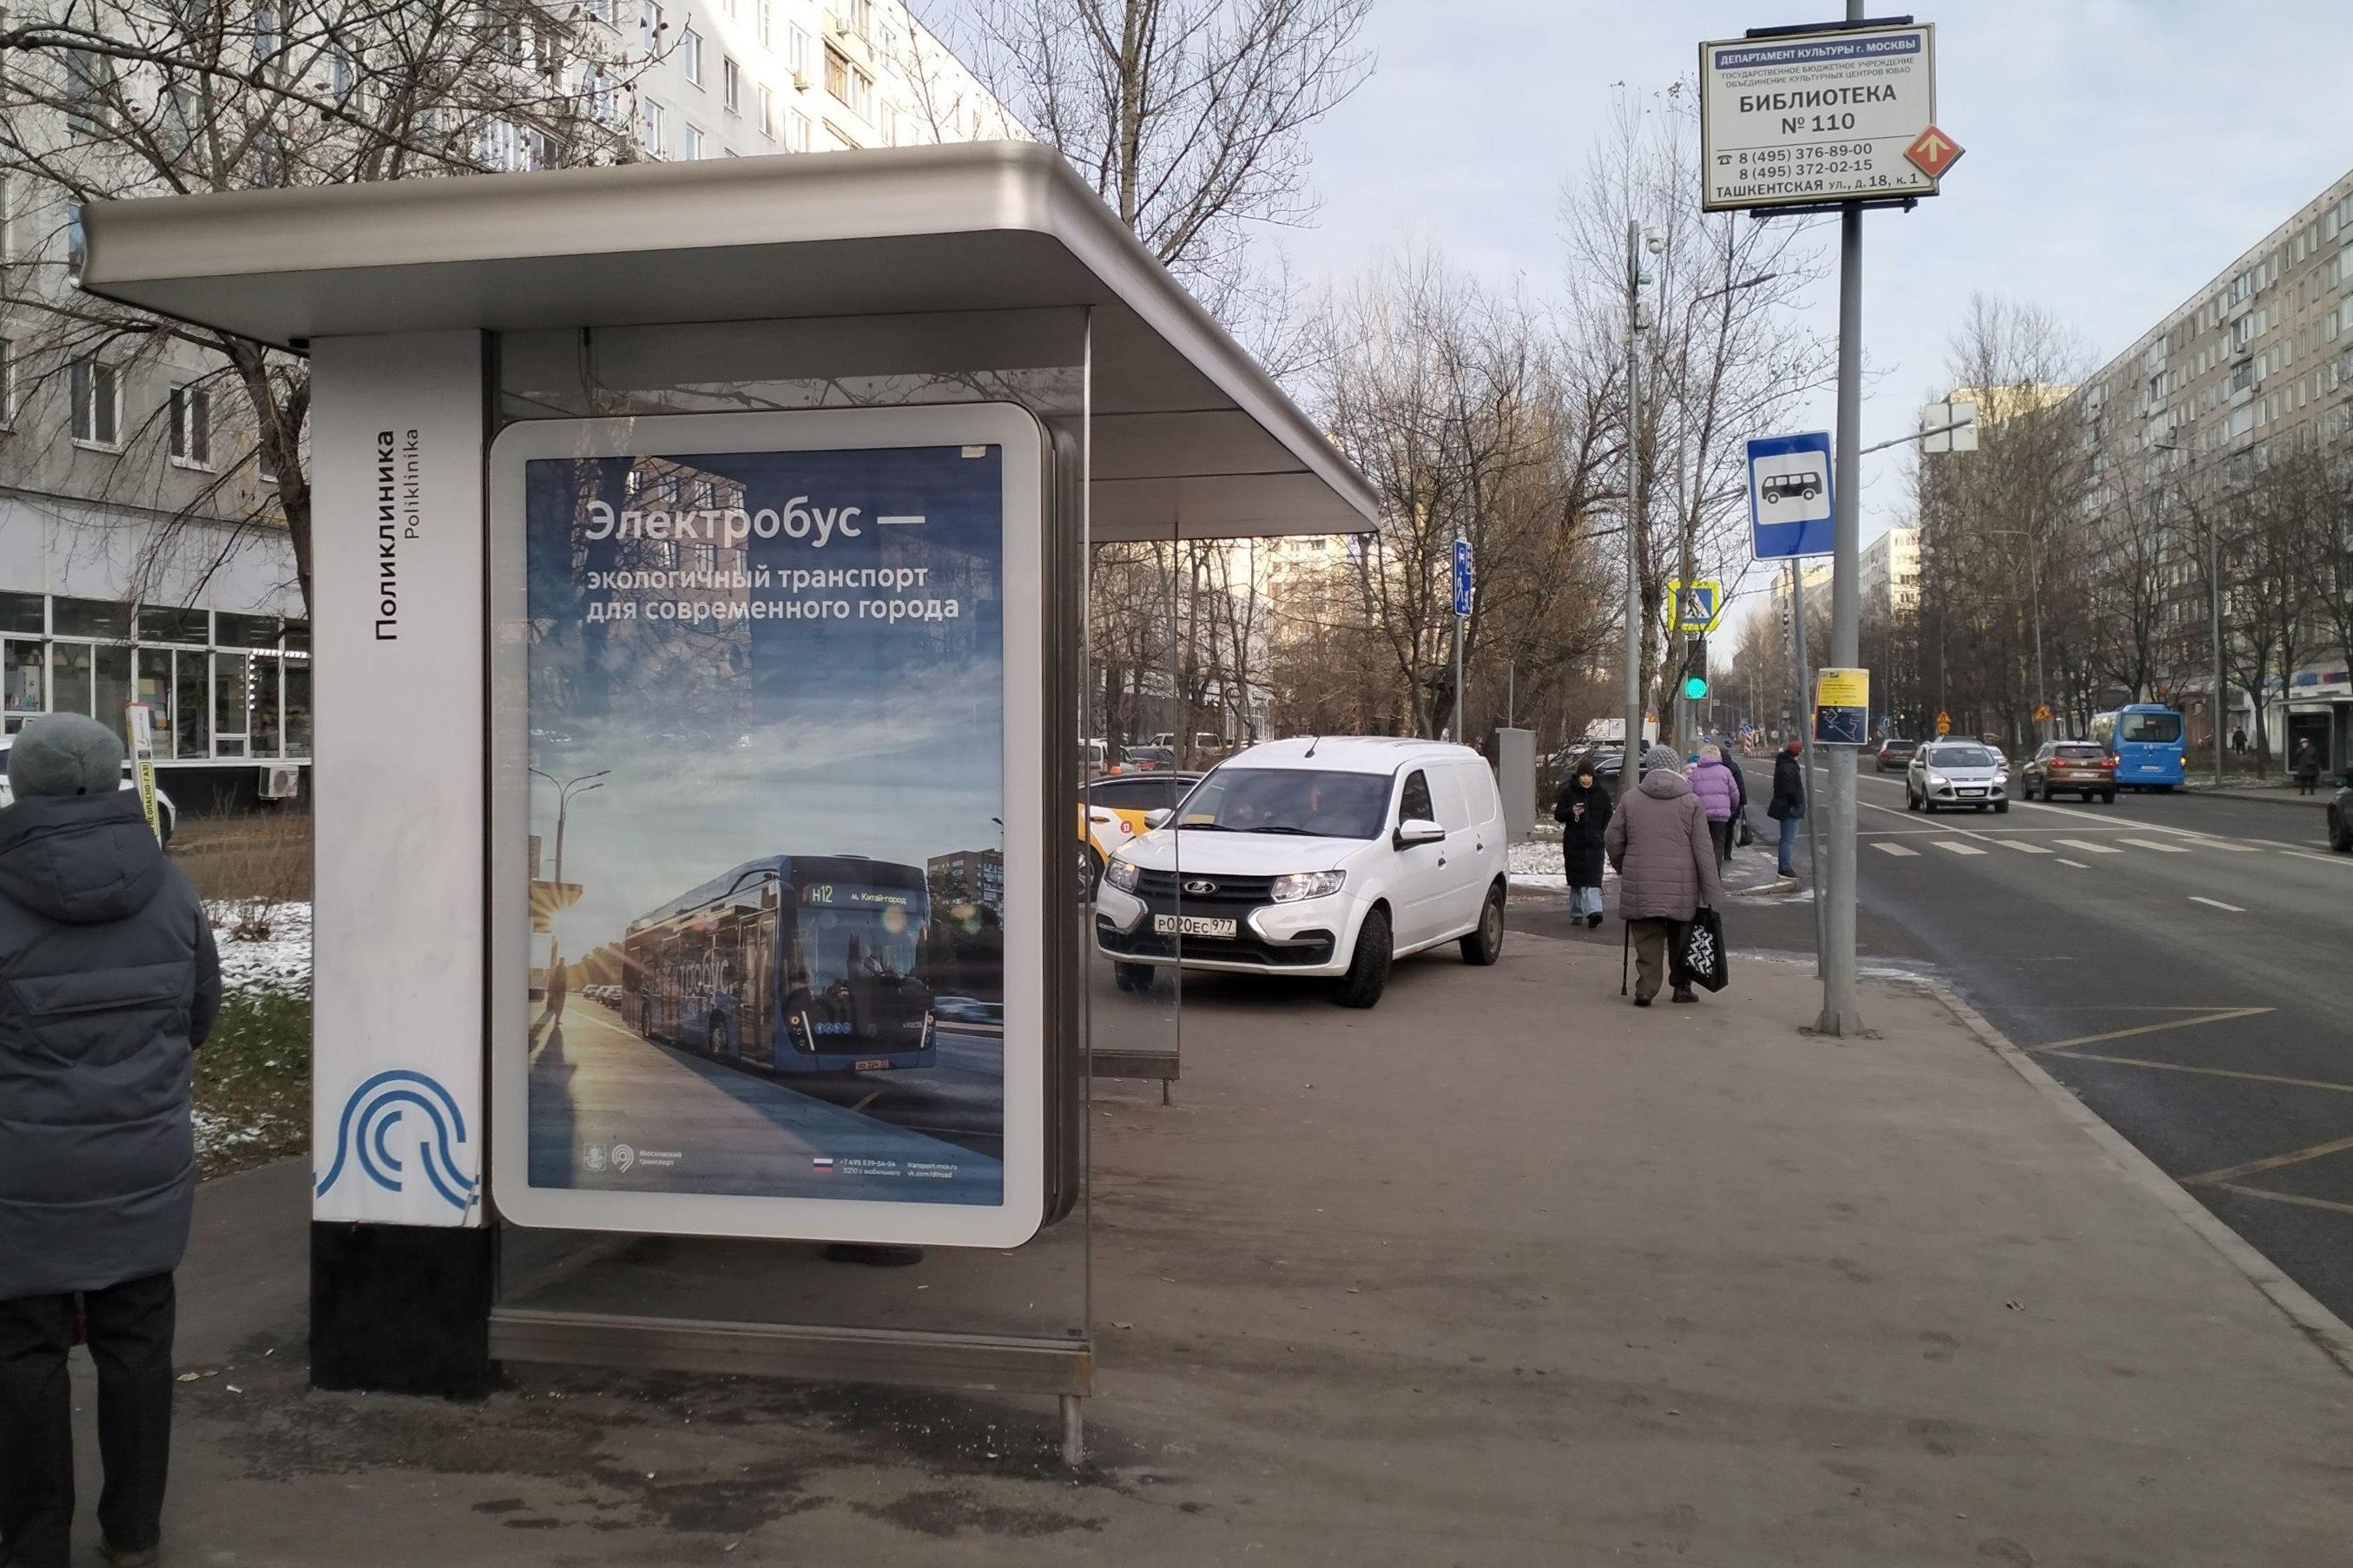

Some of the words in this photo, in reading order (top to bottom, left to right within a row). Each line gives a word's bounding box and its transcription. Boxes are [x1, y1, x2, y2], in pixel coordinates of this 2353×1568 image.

[1720, 49, 1796, 67] ДЕПАРТАМЕНТ
[1797, 44, 1854, 60] КУЛЬТУРЫ
[1866, 39, 1915, 52] МОСКВЫ
[1722, 65, 1800, 80] ГОСУДАРСТВЕННОЕ
[1802, 61, 1855, 73] БЮДЖЕТНОЕ
[1857, 57, 1915, 69] УЧРЕЖДЕНИЕ
[1725, 76, 1787, 89] ОБЪЕДИНЕНИЕ
[1789, 72, 1843, 83] КУЛЬТУРНЫХ
[1846, 69, 1883, 79] ЦЕНТРОВ
[1886, 66, 1911, 75] ЮВАО
[1739, 83, 1897, 113] БИБЛИОТЕКА
[1782, 115, 1805, 135] №
[1811, 112, 1855, 132] 110
[1739, 152, 1748, 164] 8
[1752, 148, 1791, 165] (495)
[1796, 142, 1872, 160] 376-89-00
[1739, 168, 1748, 180] 8
[1752, 164, 1791, 181] (495)
[1796, 159, 1873, 176] 372-02-15
[1716, 179, 1823, 198] ТАШКЕНТСКАЯ
[1829, 181, 1850, 190] ул.,
[1896, 176, 1906, 185] к.
[1909, 173, 1919, 185] 1
[403, 429, 419, 539] Poliklinika
[584, 495, 862, 548] Электробус
[375, 430, 398, 641] Поликлиника
[586, 563, 770, 590] экологичный
[777, 565, 928, 592] транспорт
[586, 601, 636, 623] для
[644, 598, 850, 624] современного
[859, 596, 959, 624] города
[1212, 919, 1233, 931] 977
